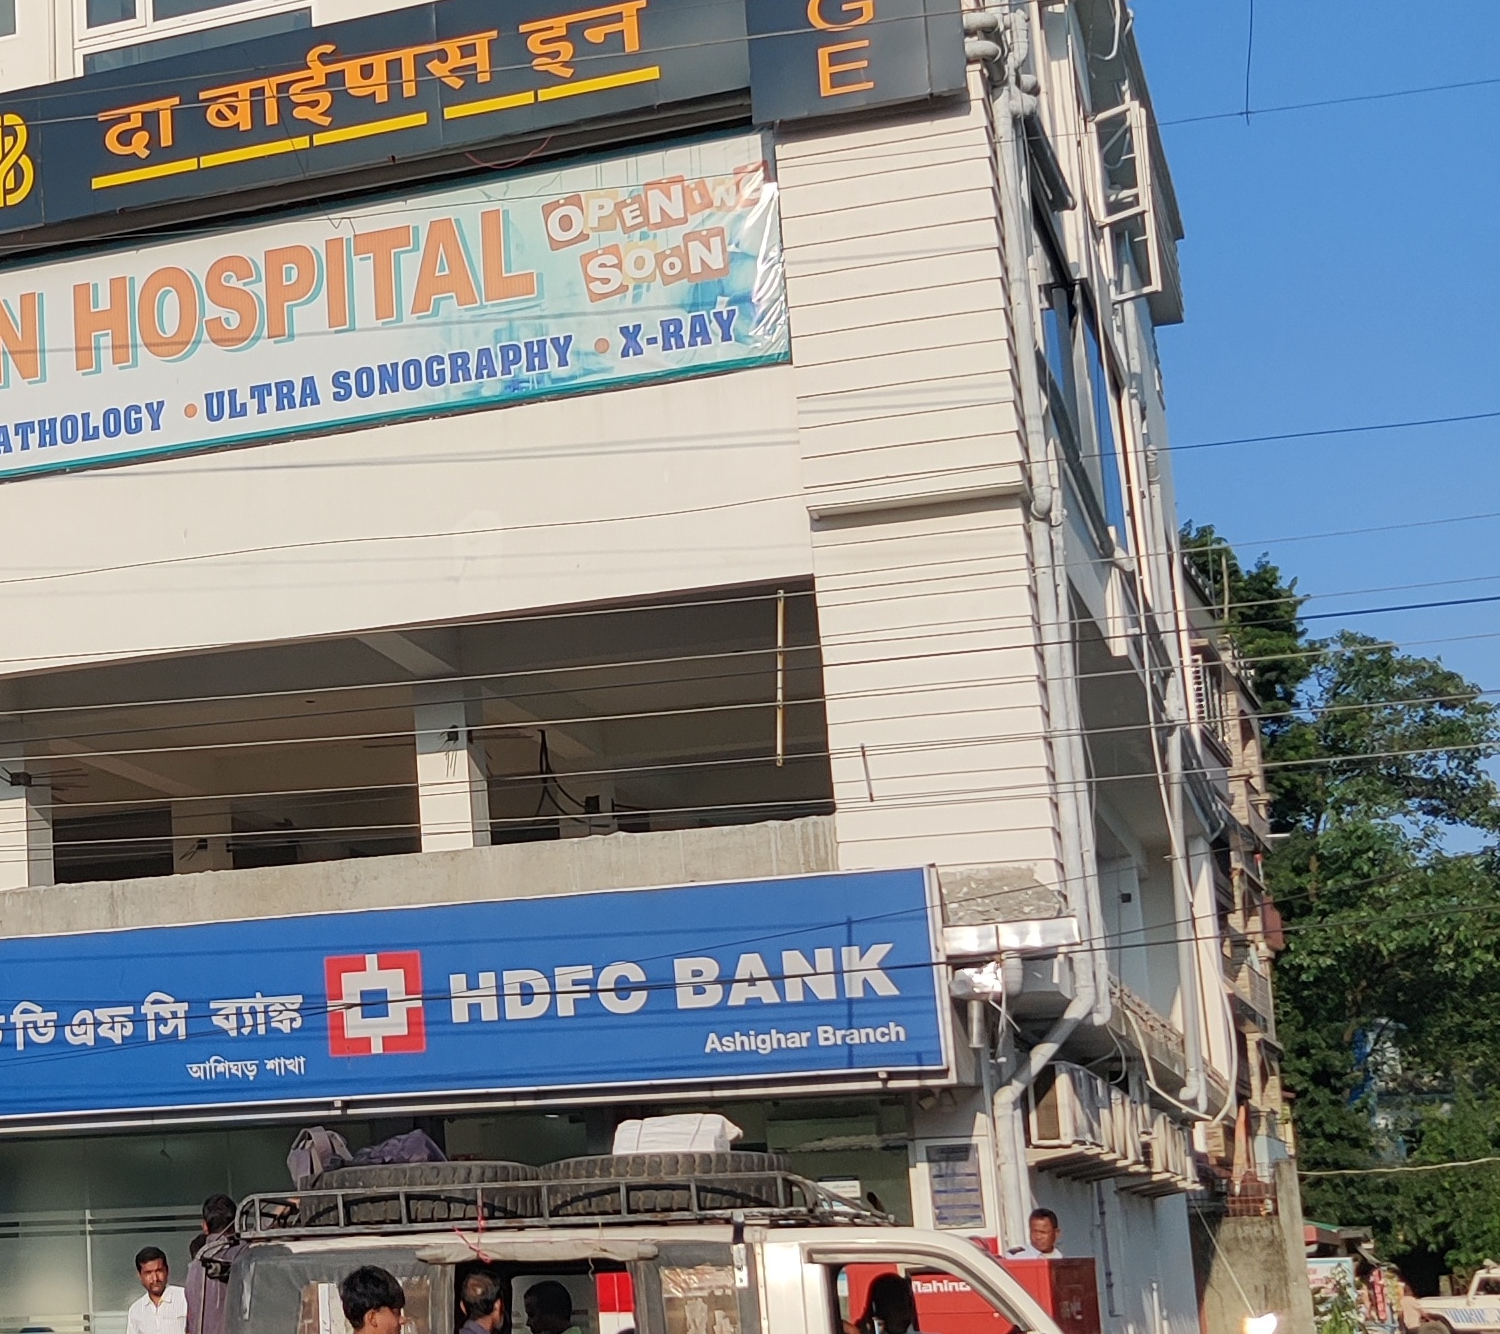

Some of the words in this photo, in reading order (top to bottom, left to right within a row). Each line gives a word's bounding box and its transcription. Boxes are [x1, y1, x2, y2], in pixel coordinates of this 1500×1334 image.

[97, 96, 180, 159] दा
[199, 29, 498, 132] बाईपास
[73, 208, 540, 370] HOSPITAL
[204, 375, 320, 422] ULTRA
[332, 334, 573, 401] SONOGRAPHY
[619, 307, 739, 358] X-RAY
[449, 961, 648, 1024] HDFC
[673, 942, 900, 1011] BANK
[264, 1055, 306, 1076] শাখা
[705, 1027, 811, 1056] Ashighar
[817, 1021, 906, 1047] Branch
